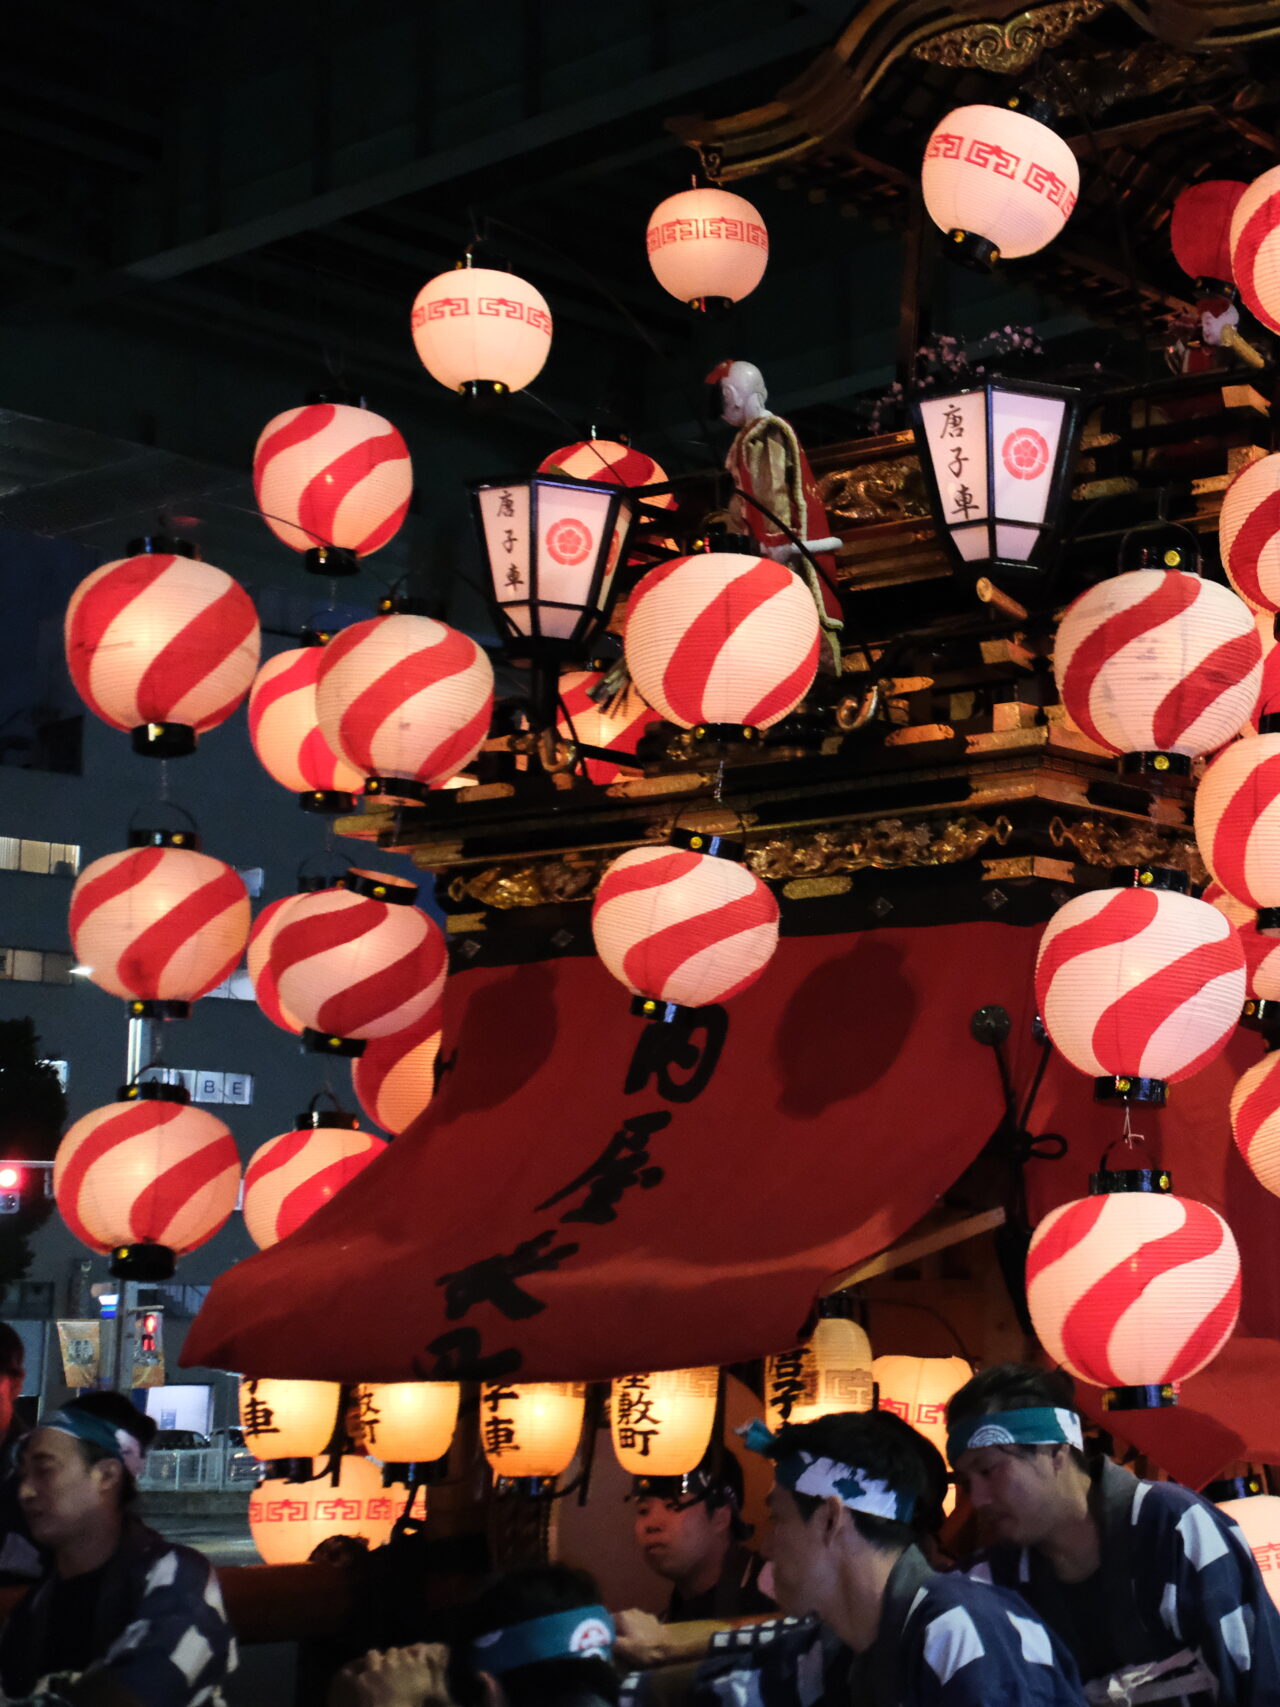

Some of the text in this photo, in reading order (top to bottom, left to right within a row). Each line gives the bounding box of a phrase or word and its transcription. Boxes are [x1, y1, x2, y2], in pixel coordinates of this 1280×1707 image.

[940, 403, 980, 520] 唐子車
[497, 489, 525, 592] 唐子車
